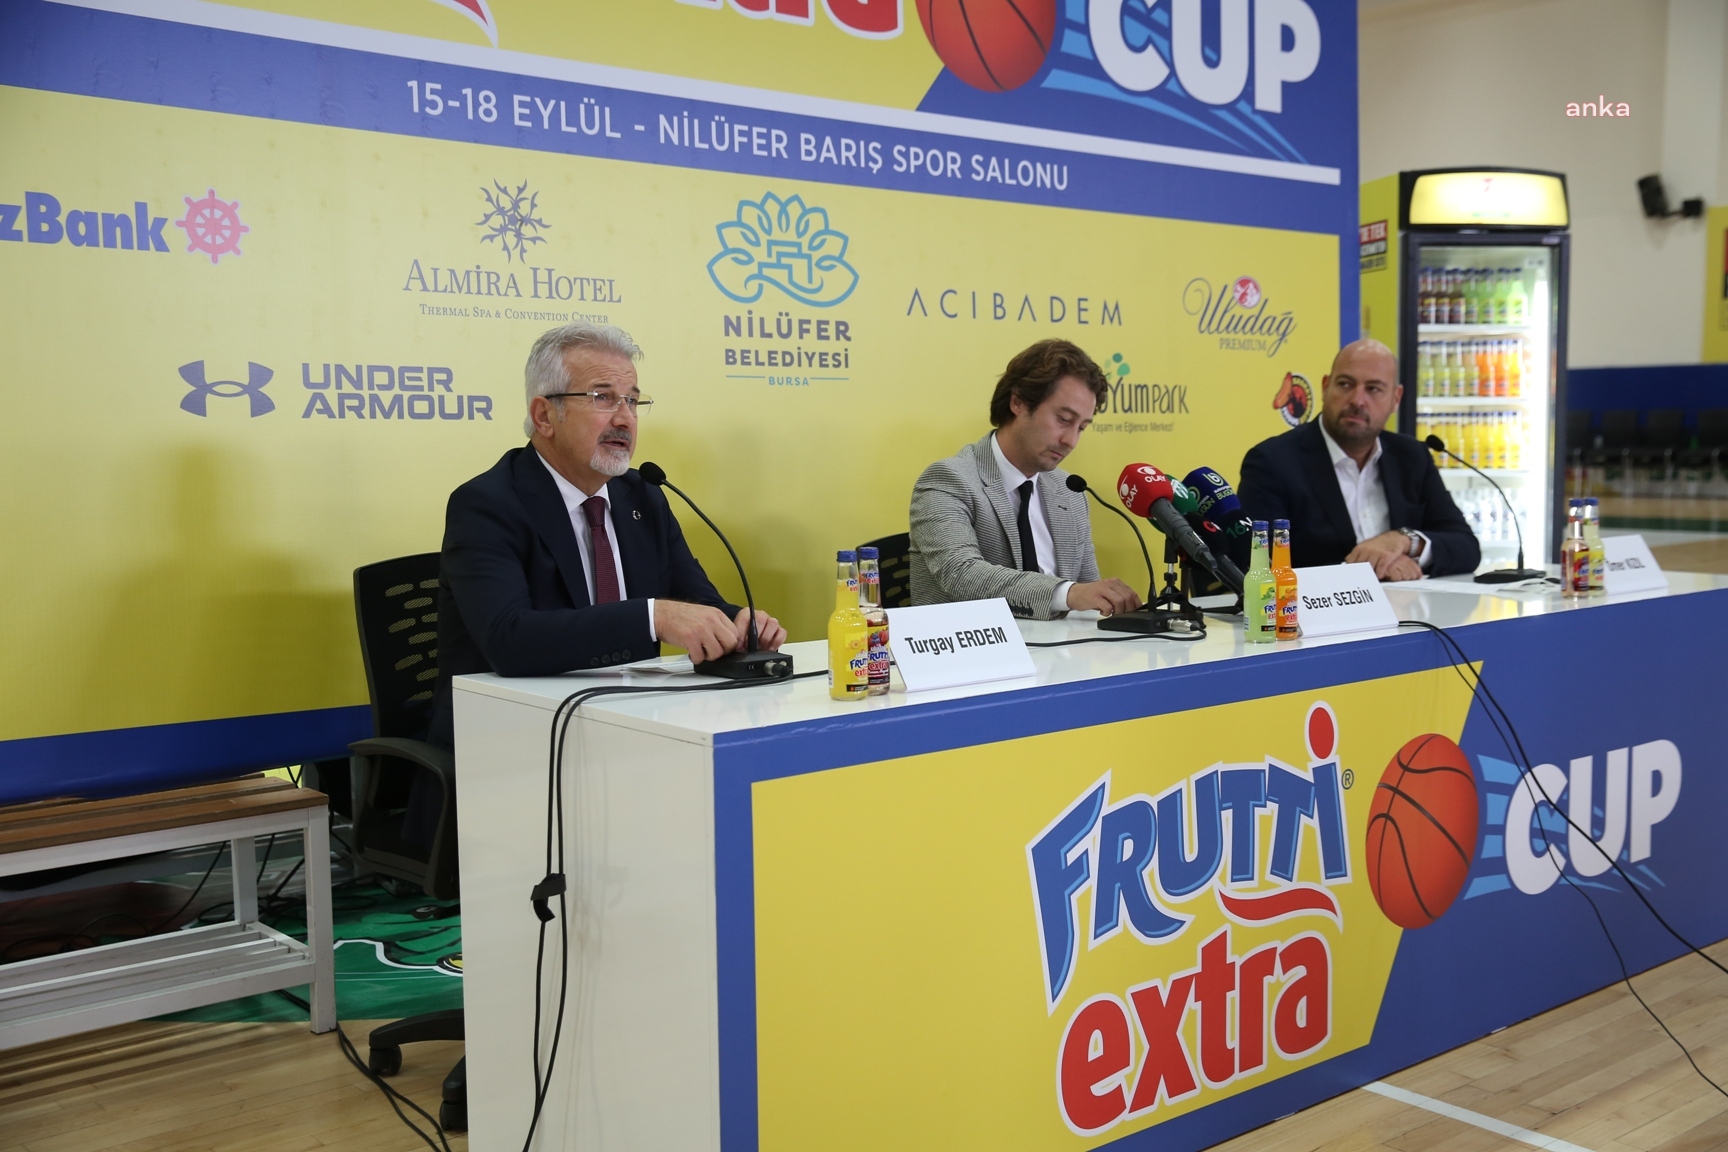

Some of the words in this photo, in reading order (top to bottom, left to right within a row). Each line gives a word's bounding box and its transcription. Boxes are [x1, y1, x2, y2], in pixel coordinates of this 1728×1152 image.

[1088, 0, 1321, 114] CUP
[407, 80, 498, 123] 15-18
[513, 94, 622, 139] EYLÜL
[659, 111, 788, 159] NİLÜFER
[800, 132, 883, 174] BARIŞ
[893, 144, 962, 179] SPOR
[971, 154, 1069, 190] SALONU
[402, 258, 523, 298] ALMİRA
[529, 266, 622, 303] HOTEL
[419, 303, 470, 317] THERMAL
[473, 306, 492, 318] SPA
[505, 308, 569, 322] CONVENTION
[906, 287, 1122, 327] ACIBADEM
[1182, 277, 1297, 358] Uludağ
[723, 310, 852, 342] NİLÜFER
[725, 346, 849, 368] BELEDİYESİ
[1219, 337, 1268, 351] PREMIUM
[301, 363, 454, 392] UNDER
[768, 376, 810, 387] BURSA
[301, 392, 493, 421] ARMOUR
[1144, 475, 1167, 483] OLAY
[1126, 484, 1139, 508] OLAY
[1302, 595, 1333, 610] Sezer
[1333, 587, 1375, 606] SEZGİN
[904, 637, 955, 655] Turgay
[955, 626, 1008, 648] ERDEM
[1505, 739, 1683, 896] CUP
[1058, 925, 1331, 1137] extra
